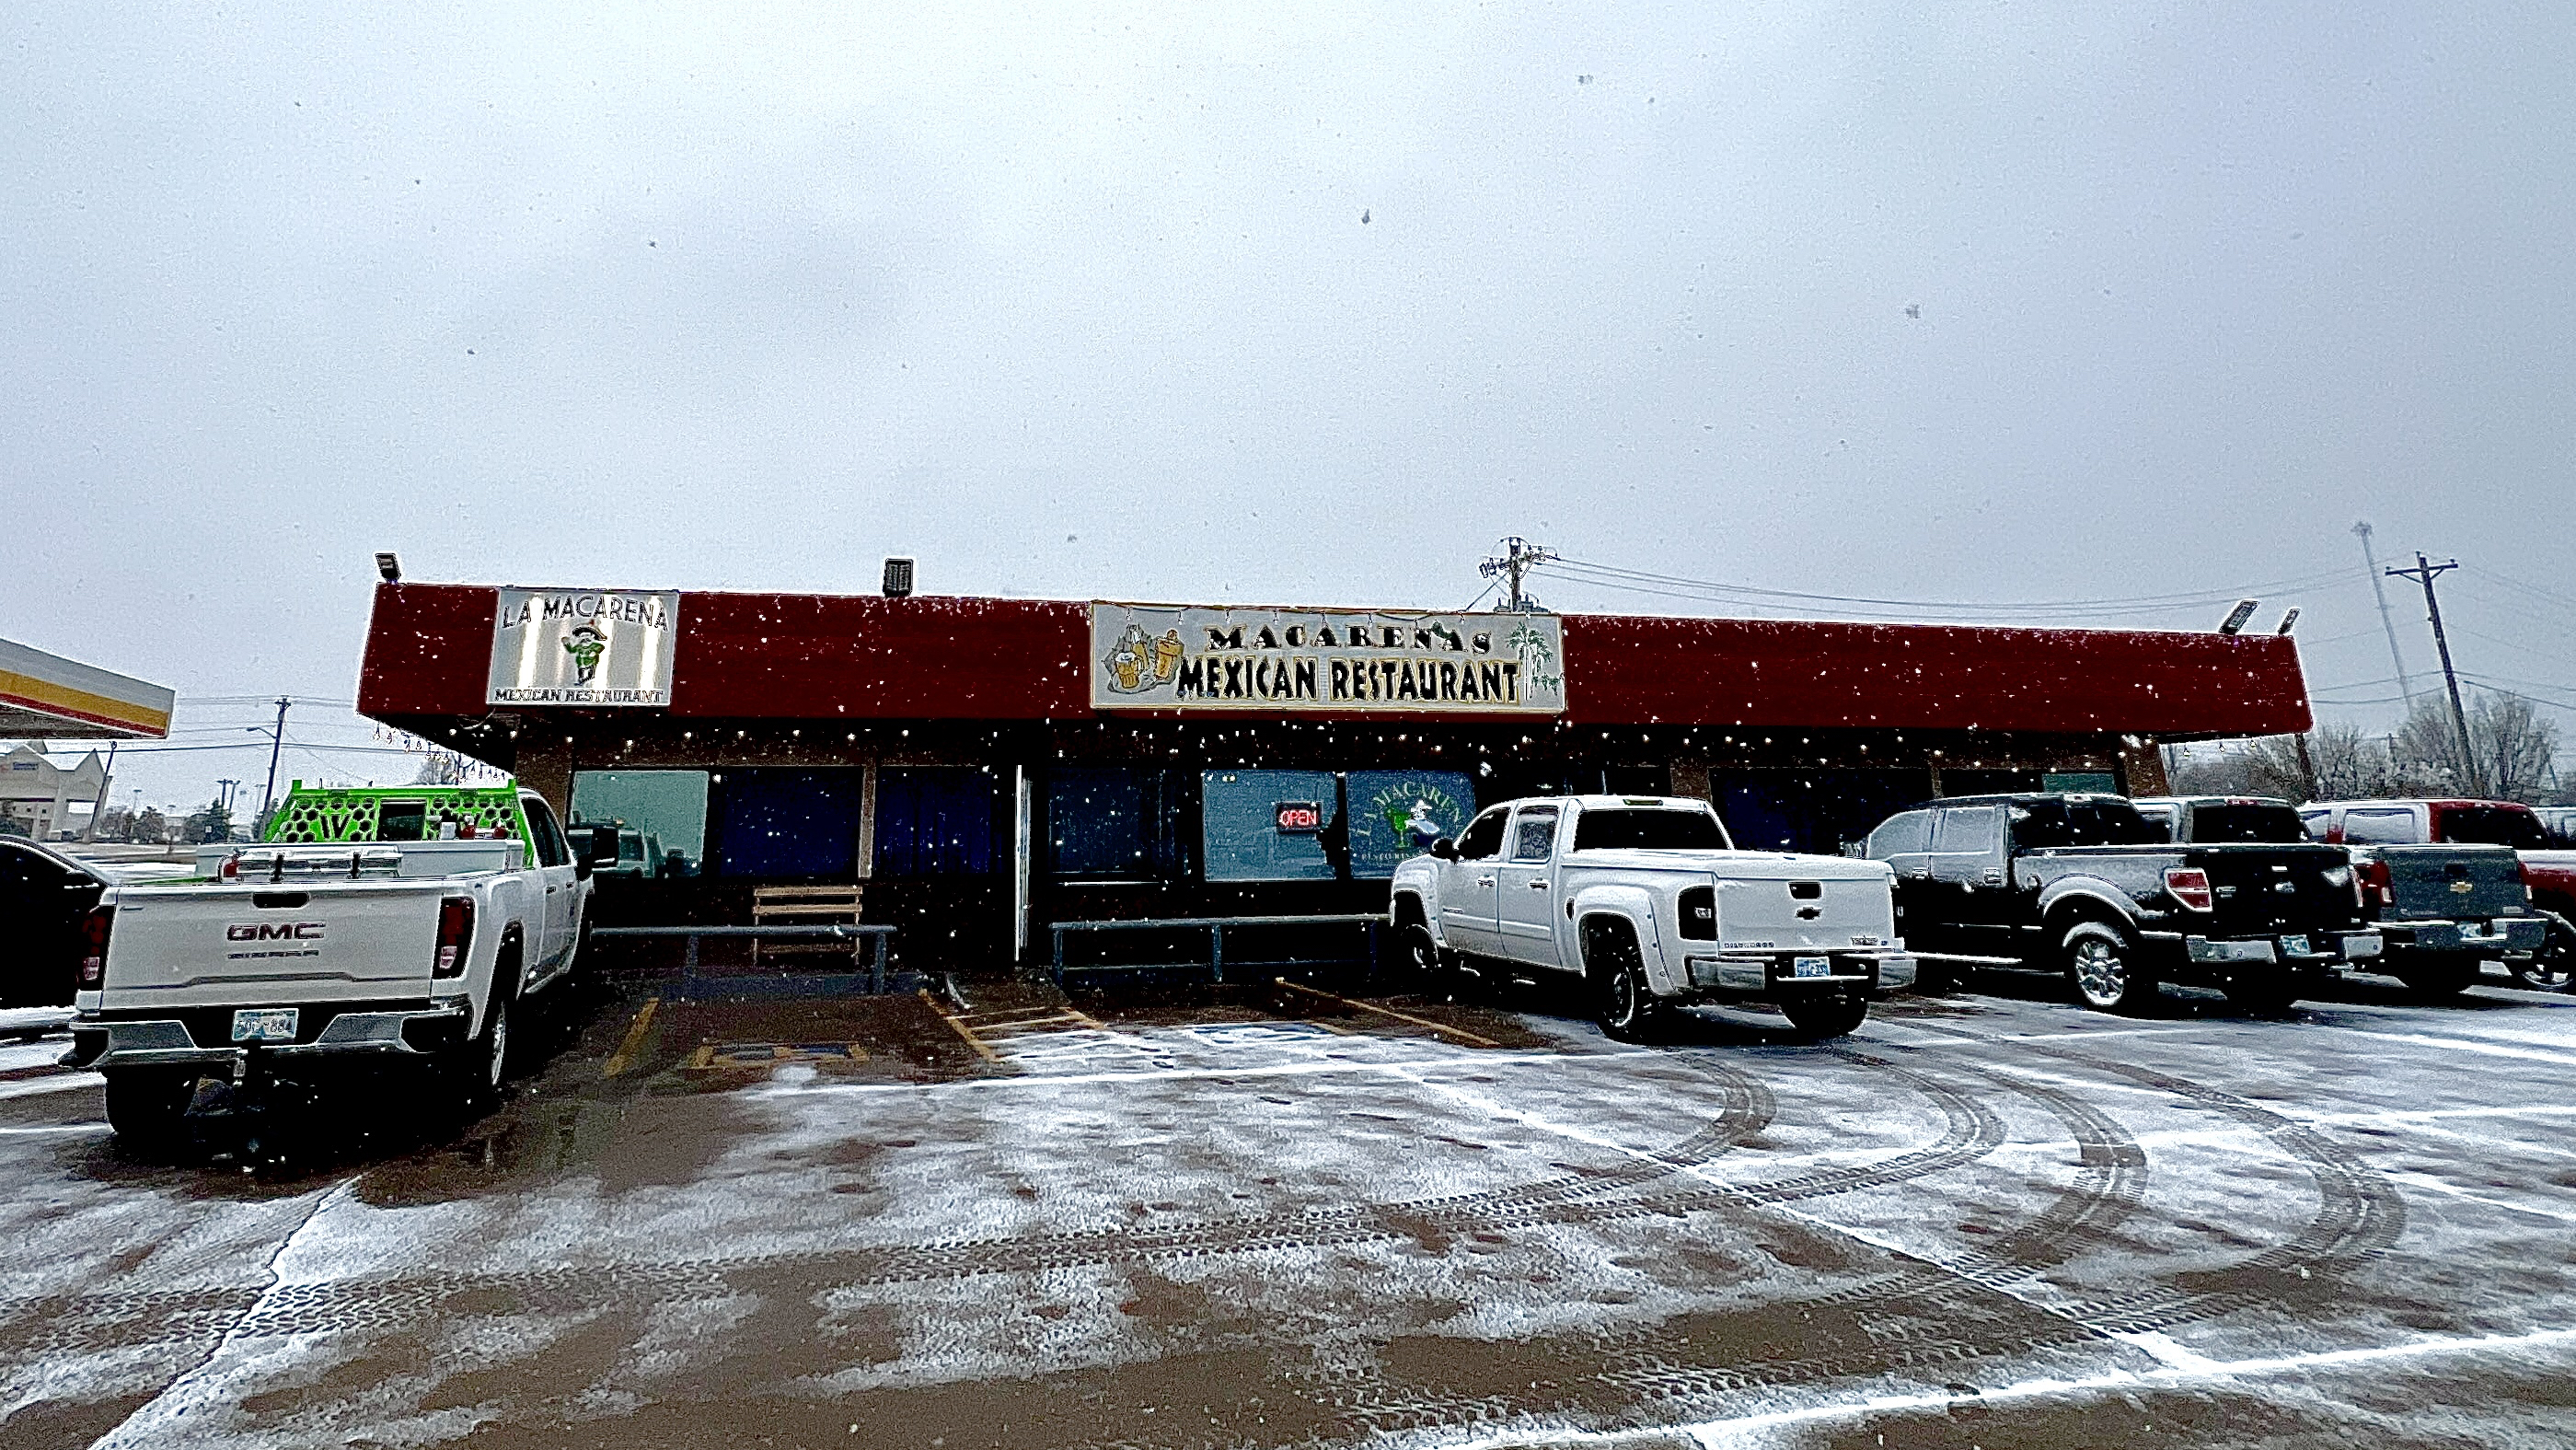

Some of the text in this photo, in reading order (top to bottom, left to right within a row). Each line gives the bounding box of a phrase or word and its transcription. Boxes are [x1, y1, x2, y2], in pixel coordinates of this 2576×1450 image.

[502, 595, 669, 632] LA MACARENA
[1203, 623, 1493, 655] MACARENAS
[494, 688, 664, 703] MEXICAN RESTAURANT
[1176, 655, 1520, 705] MEXICAN RESTAURANT
[1279, 809, 1318, 828] OPEN
[1372, 781, 1465, 828] MACAREN
[226, 922, 326, 941] GMC
